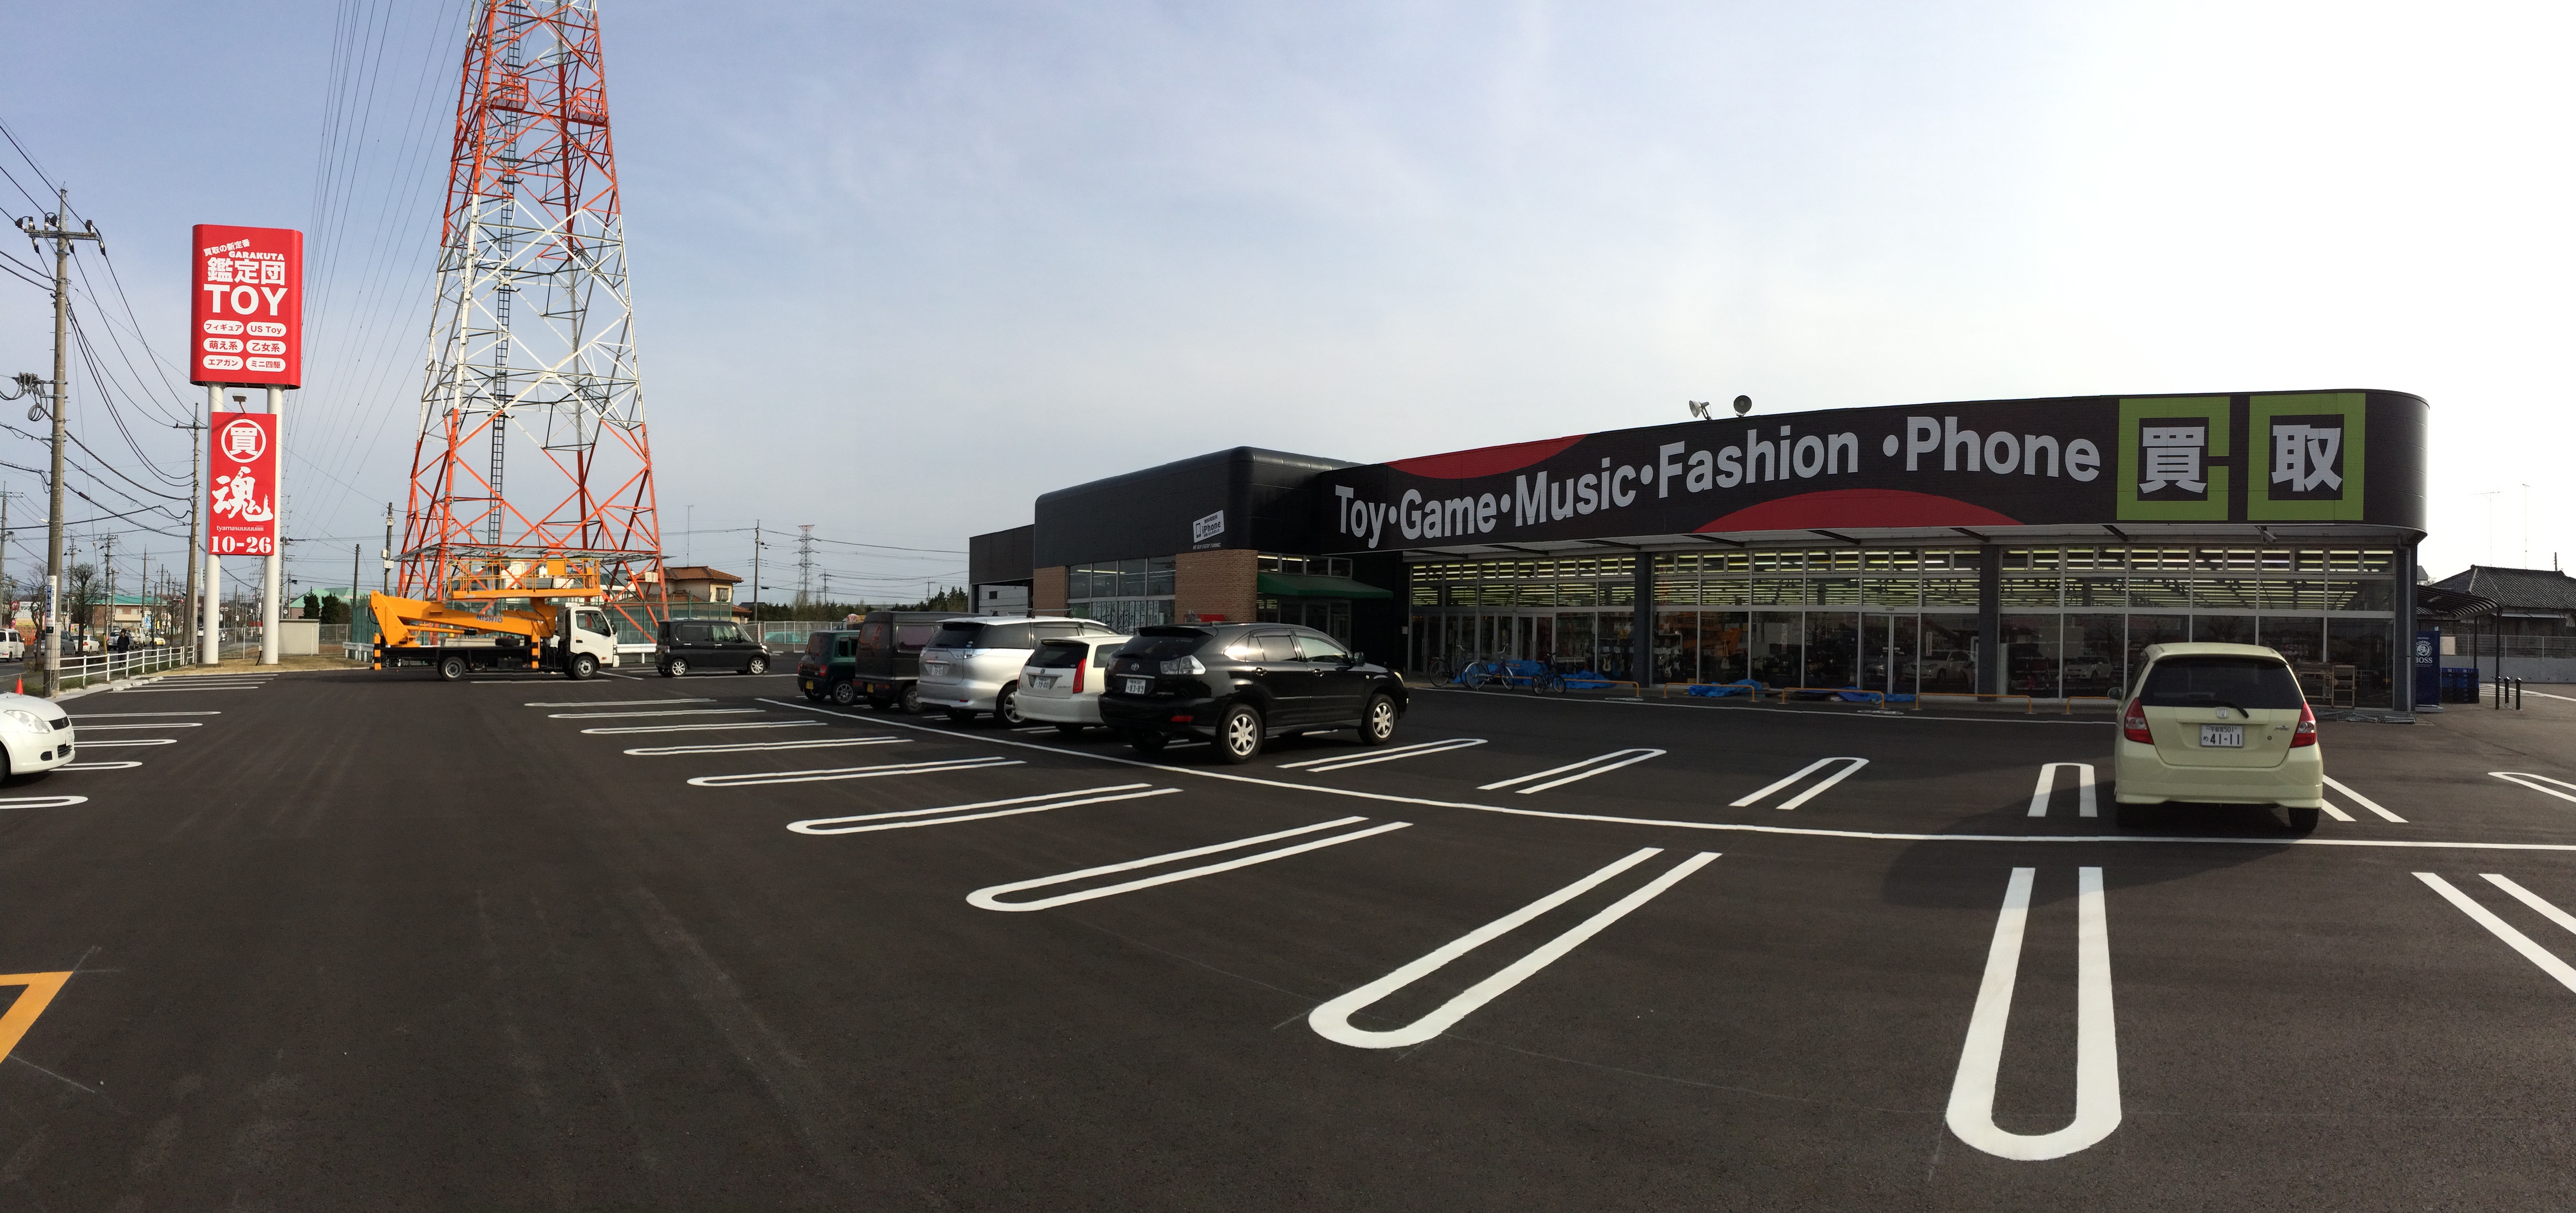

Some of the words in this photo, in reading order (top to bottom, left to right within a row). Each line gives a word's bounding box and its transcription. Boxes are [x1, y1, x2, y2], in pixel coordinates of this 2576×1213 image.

[203, 238, 250, 257] 買取の新定番
[229, 250, 285, 260] GARAKUTA
[207, 257, 286, 285] 鑑定団
[203, 284, 288, 316] TOY
[205, 323, 242, 332] フィギュア
[266, 326, 282, 335] Toy
[209, 340, 238, 350] 萌え系
[252, 342, 280, 352] 乙女系
[251, 360, 281, 369] ミニ四駆
[229, 427, 259, 456] 買
[2139, 424, 2343, 494] 買取
[212, 466, 274, 522] 魂
[1202, 521, 1221, 534] iPhone
[212, 536, 271, 553] 10-26
[476, 614, 503, 623] NISHIO
[2210, 733, 2239, 745] 41-11
